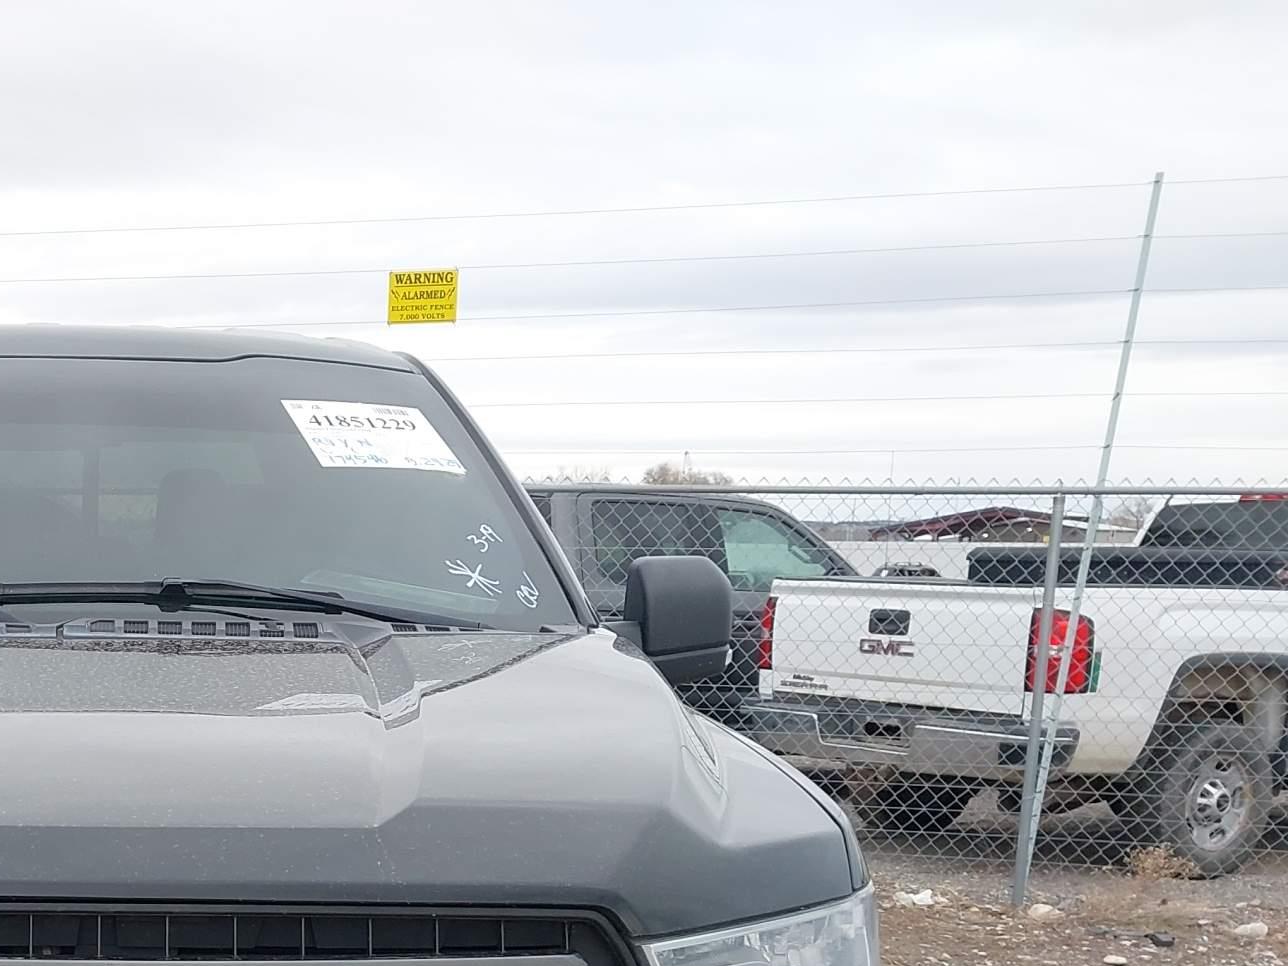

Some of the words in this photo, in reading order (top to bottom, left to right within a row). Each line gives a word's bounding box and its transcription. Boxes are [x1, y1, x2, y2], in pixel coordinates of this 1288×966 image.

[395, 272, 454, 285] WARNING
[401, 290, 446, 300] ALARMED
[392, 304, 428, 312] ELECTRIC
[421, 312, 445, 320] VOLTS
[308, 414, 417, 431] 41851229
[860, 638, 915, 657] GMC
